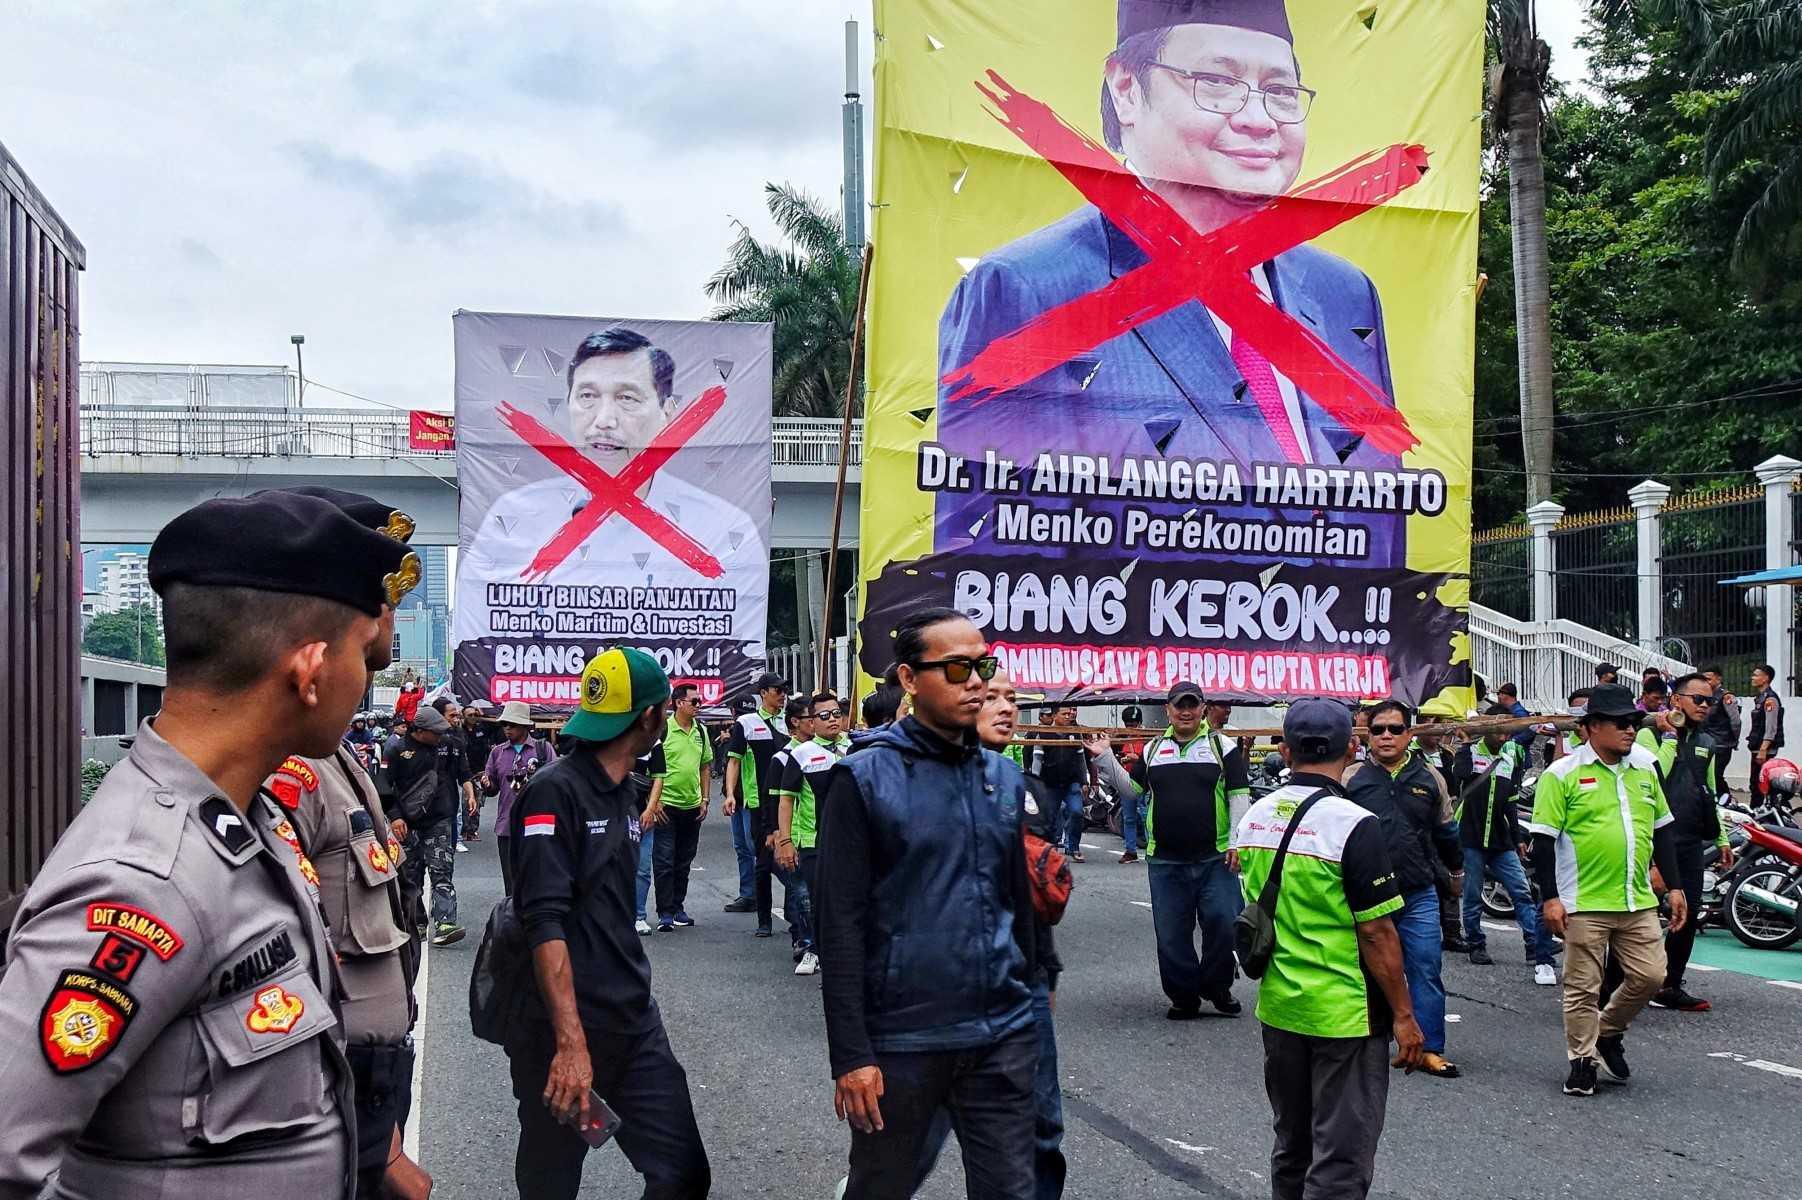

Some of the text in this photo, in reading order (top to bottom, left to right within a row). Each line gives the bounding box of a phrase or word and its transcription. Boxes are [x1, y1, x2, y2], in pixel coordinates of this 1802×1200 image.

[415, 430, 450, 443] Jangan
[425, 417, 446, 428] Aksi
[921, 446, 1443, 512] Dr. Ir. AIRLANGGA HARTARTO
[997, 503, 1367, 556] Menko Perekonomian
[487, 584, 735, 611] LUHUT BINSAR PANJAITAN
[954, 569, 1127, 635] BIANG
[491, 611, 731, 636] Menko Maritim & Investasi
[495, 644, 585, 675] BIANG
[1145, 648, 1161, 687] &
[1164, 651, 1246, 690] PERPPU
[1250, 655, 1312, 692] CIPTA
[1317, 657, 1387, 696] KERJA
[495, 680, 582, 700] PENUND
[281, 759, 314, 785] AMAPTA
[93, 908, 175, 954] DIT SAMAPTA
[104, 943, 135, 973] 5
[64, 974, 135, 1016] KORPS SABHARA
